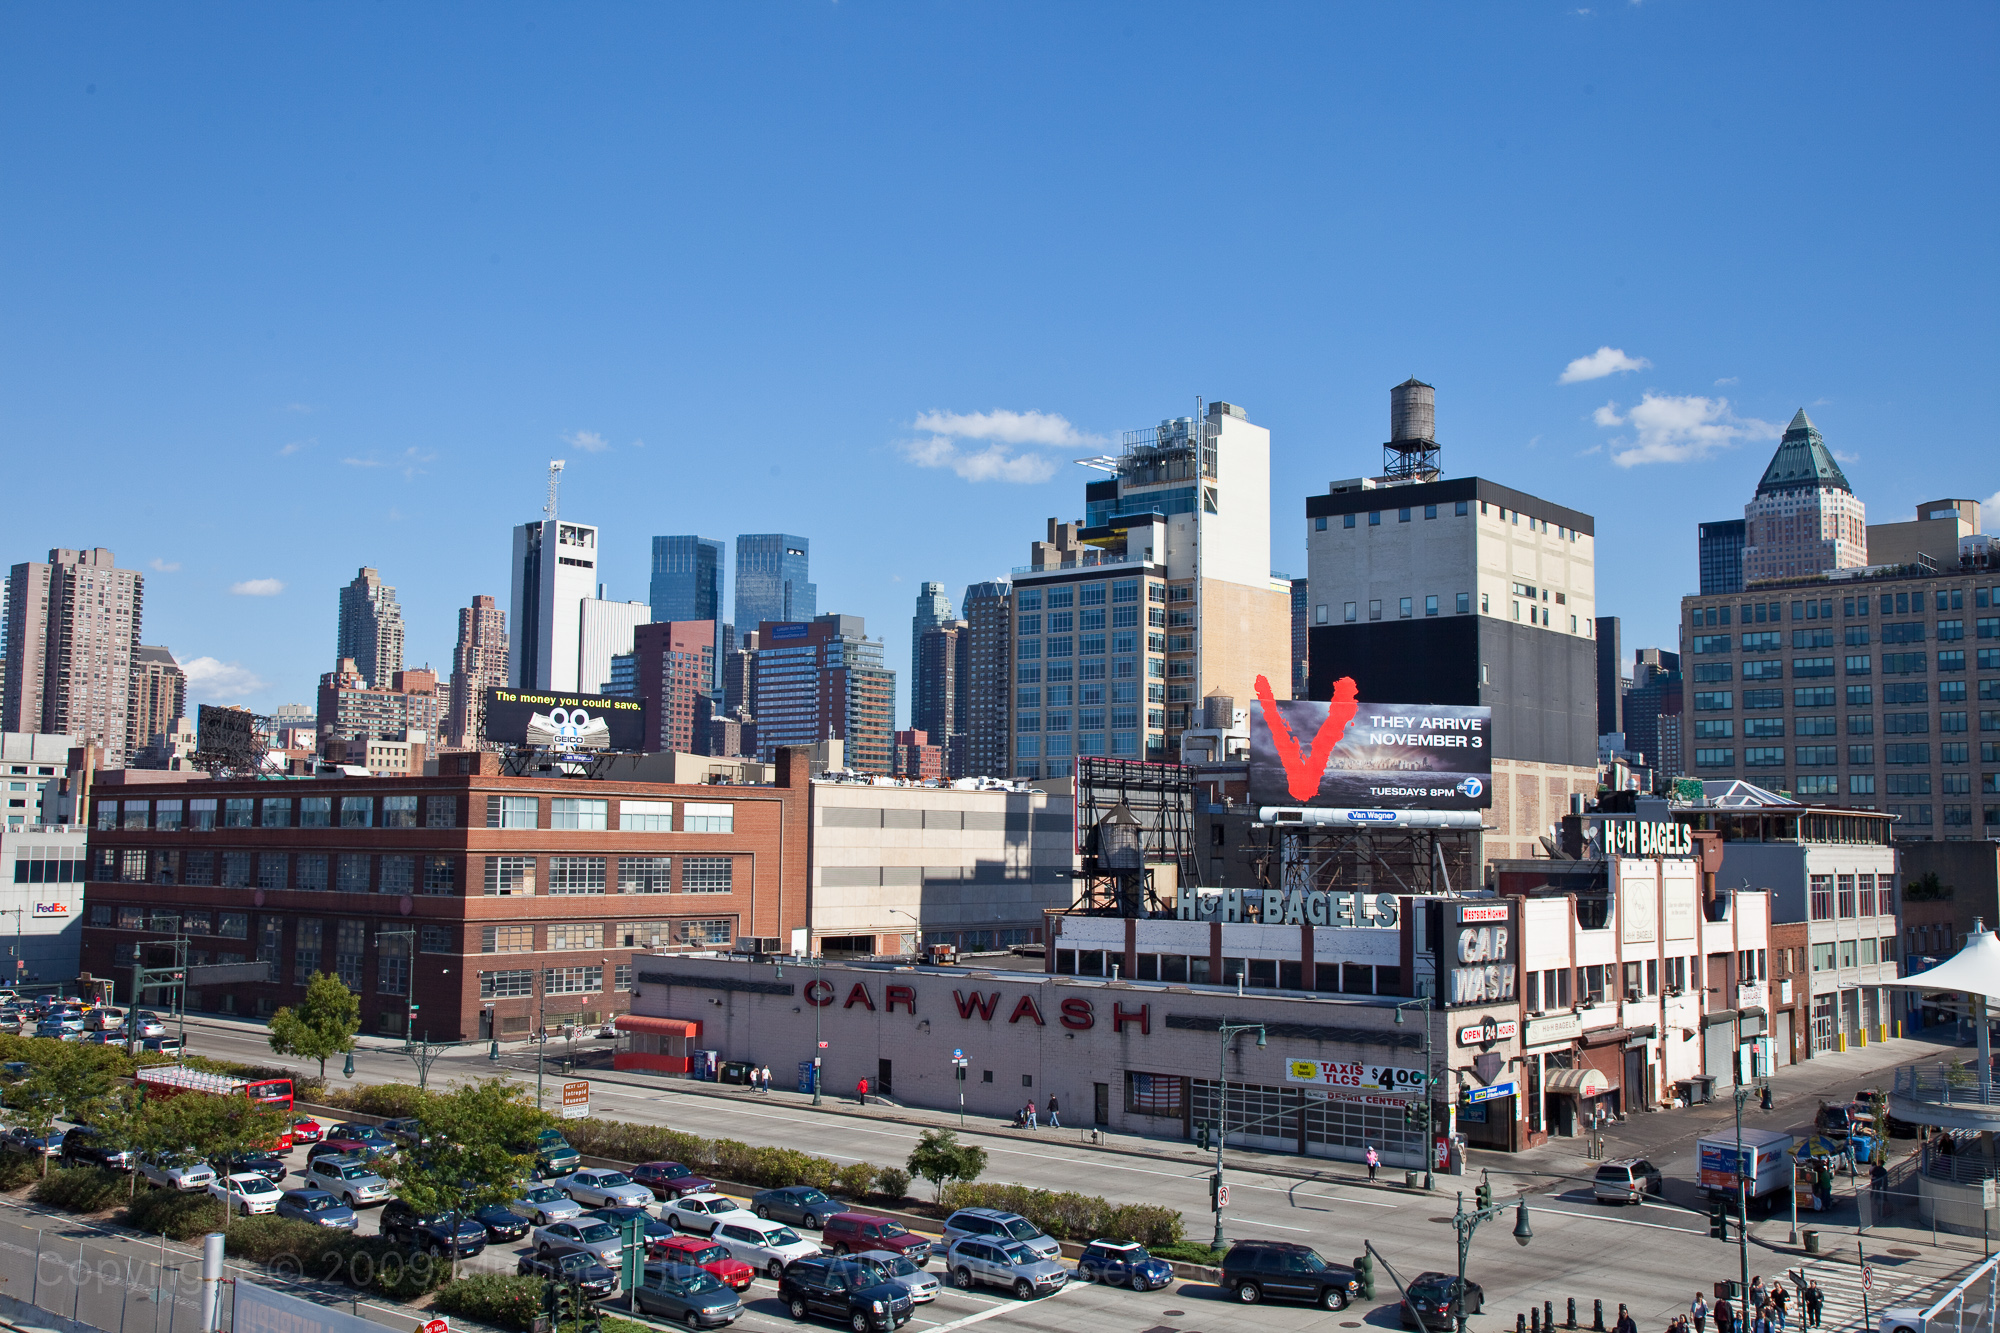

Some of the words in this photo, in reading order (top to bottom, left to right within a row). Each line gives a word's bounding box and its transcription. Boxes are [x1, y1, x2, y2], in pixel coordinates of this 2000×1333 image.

[496, 691, 517, 702] The
[520, 693, 556, 706] money
[560, 697, 579, 707] you
[582, 698, 612, 708] could
[614, 702, 641, 711] save.
[1370, 715, 1416, 729] THEY
[1420, 717, 1482, 731] ARRIVE
[554, 735, 584, 744] GEICO
[1254, 674, 1359, 802] V
[1369, 733, 1468, 748] NOVEMBER
[1471, 736, 1483, 748] 3
[1370, 787, 1427, 797] TUESDAYS
[1430, 788, 1455, 797] 8PM
[1352, 811, 1366, 819] Van
[1367, 811, 1394, 821] Wagner
[1605, 820, 1637, 854] H&H
[1640, 821, 1692, 854] BAGELS
[36, 902, 67, 913] FedEx
[1177, 887, 1244, 923] H&H
[1263, 889, 1398, 928] BAGELS
[1639, 930, 1653, 939] BAGELS
[1458, 926, 1508, 963] CAR
[1451, 964, 1516, 1004] WASH
[803, 979, 917, 1015] CAR
[953, 988, 1150, 1035] WASH
[1463, 1029, 1481, 1040] OPEN
[1485, 1025, 1496, 1040] 24
[1499, 1024, 1515, 1035] HOURS
[1555, 1020, 1576, 1031] BAGELS
[1321, 1062, 1364, 1076] TAXIS
[1324, 1073, 1360, 1086] TLCS
[565, 1089, 587, 1097] Intrepid
[565, 1097, 587, 1105] Museum
[1366, 1095, 1407, 1107] CENTER
[1702, 1145, 1721, 1154] Budget
[434, 1323, 446, 1332] NOT
